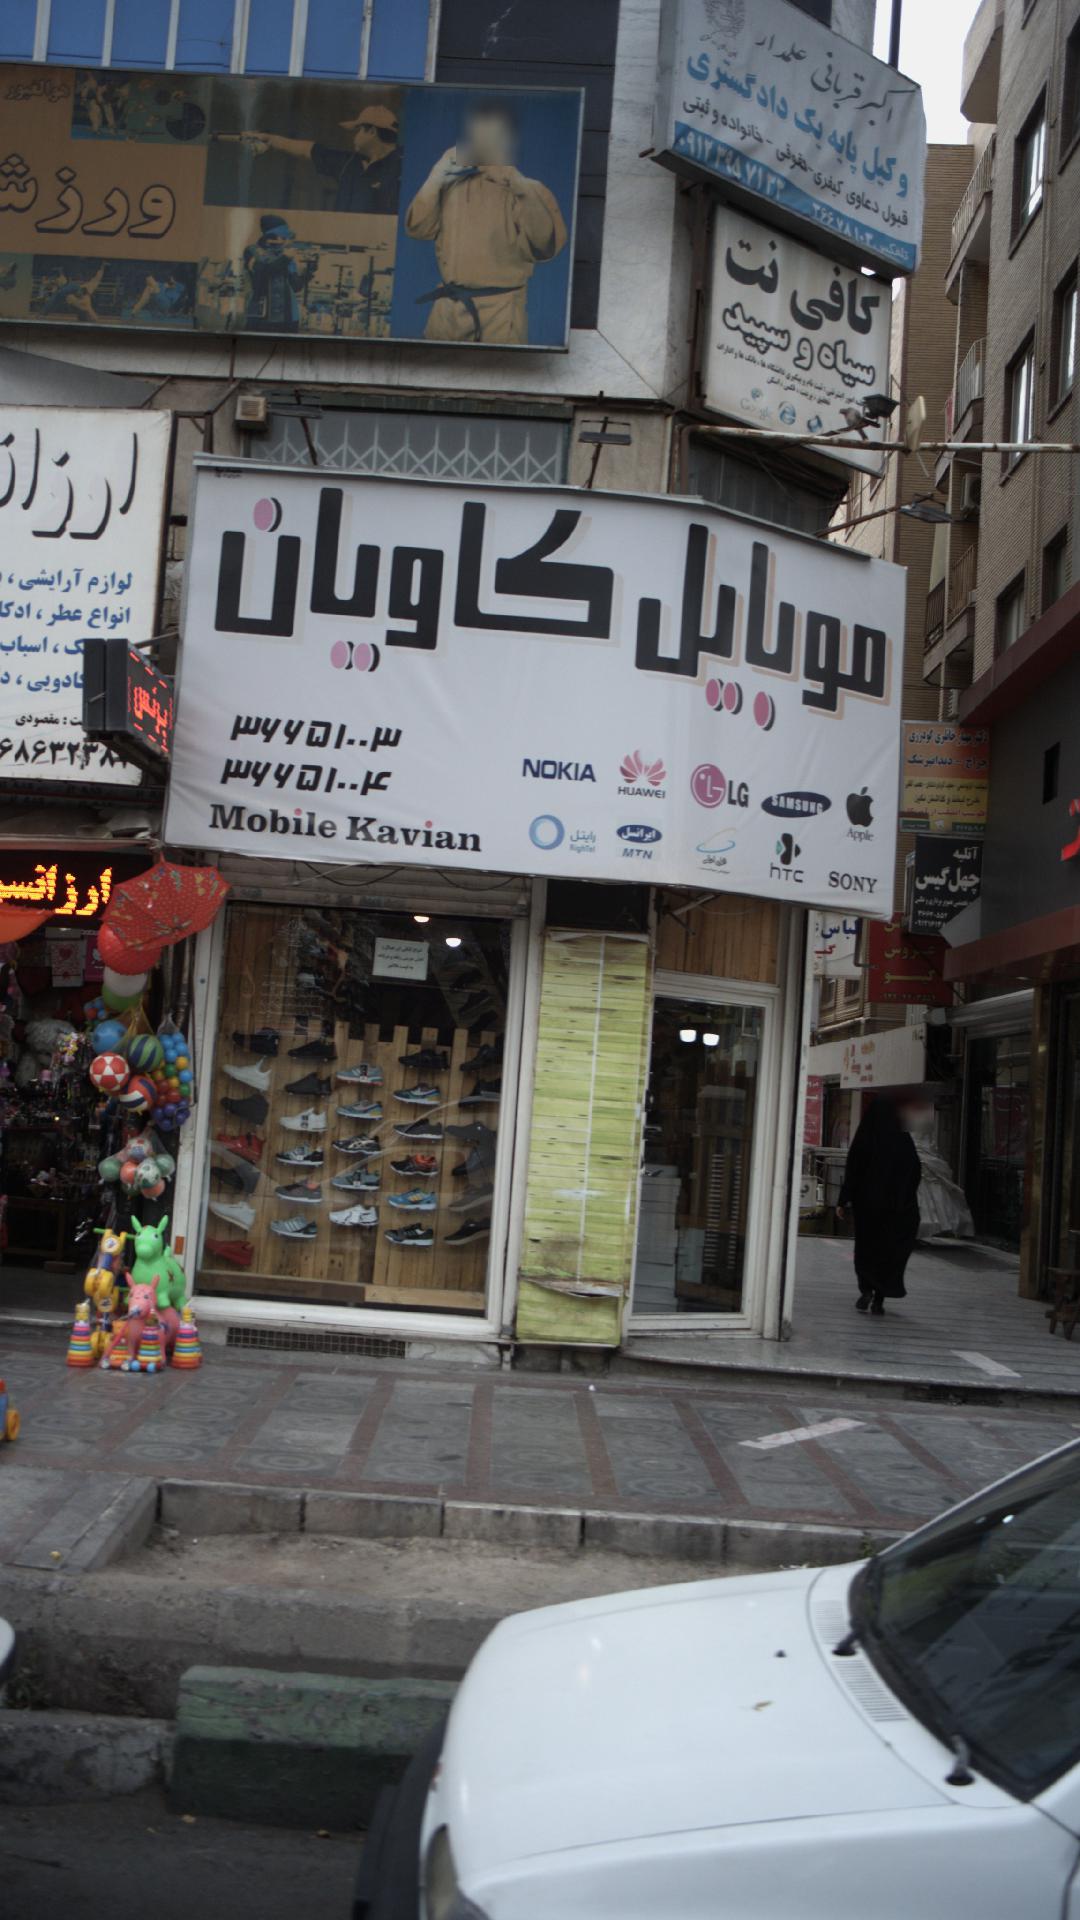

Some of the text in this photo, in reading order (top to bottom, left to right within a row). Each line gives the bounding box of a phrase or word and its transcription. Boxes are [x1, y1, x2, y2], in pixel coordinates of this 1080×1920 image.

[810, 51, 865, 109] قربانی
[711, 109, 719, 125] و
[856, 89, 916, 126] اکبر
[720, 114, 763, 143] خانواده
[794, 108, 822, 150] یک
[828, 129, 857, 175] پایه
[813, 172, 843, 197] کیفری
[862, 146, 908, 198] وکیل
[846, 191, 880, 214] دعاوی
[882, 204, 908, 228] قبول
[726, 239, 880, 335] کافی نت
[793, 337, 814, 371] و
[818, 339, 875, 387] سیاه
[18, 568, 133, 595] لوازم آرایشی
[46, 603, 83, 626] عطر
[87, 606, 131, 629] انواع
[214, 487, 888, 731] موبایل کاویان
[15, 713, 60, 728] مقصودی
[522, 758, 597, 783] NOKIA
[617, 786, 666, 799] HUAWEI
[727, 780, 749, 808] LG
[770, 796, 824, 815] SAMSUNG
[209, 803, 483, 852] Mobile Kavian
[846, 828, 874, 843] Apple
[621, 847, 653, 860] MTN
[828, 870, 878, 894] SONY
